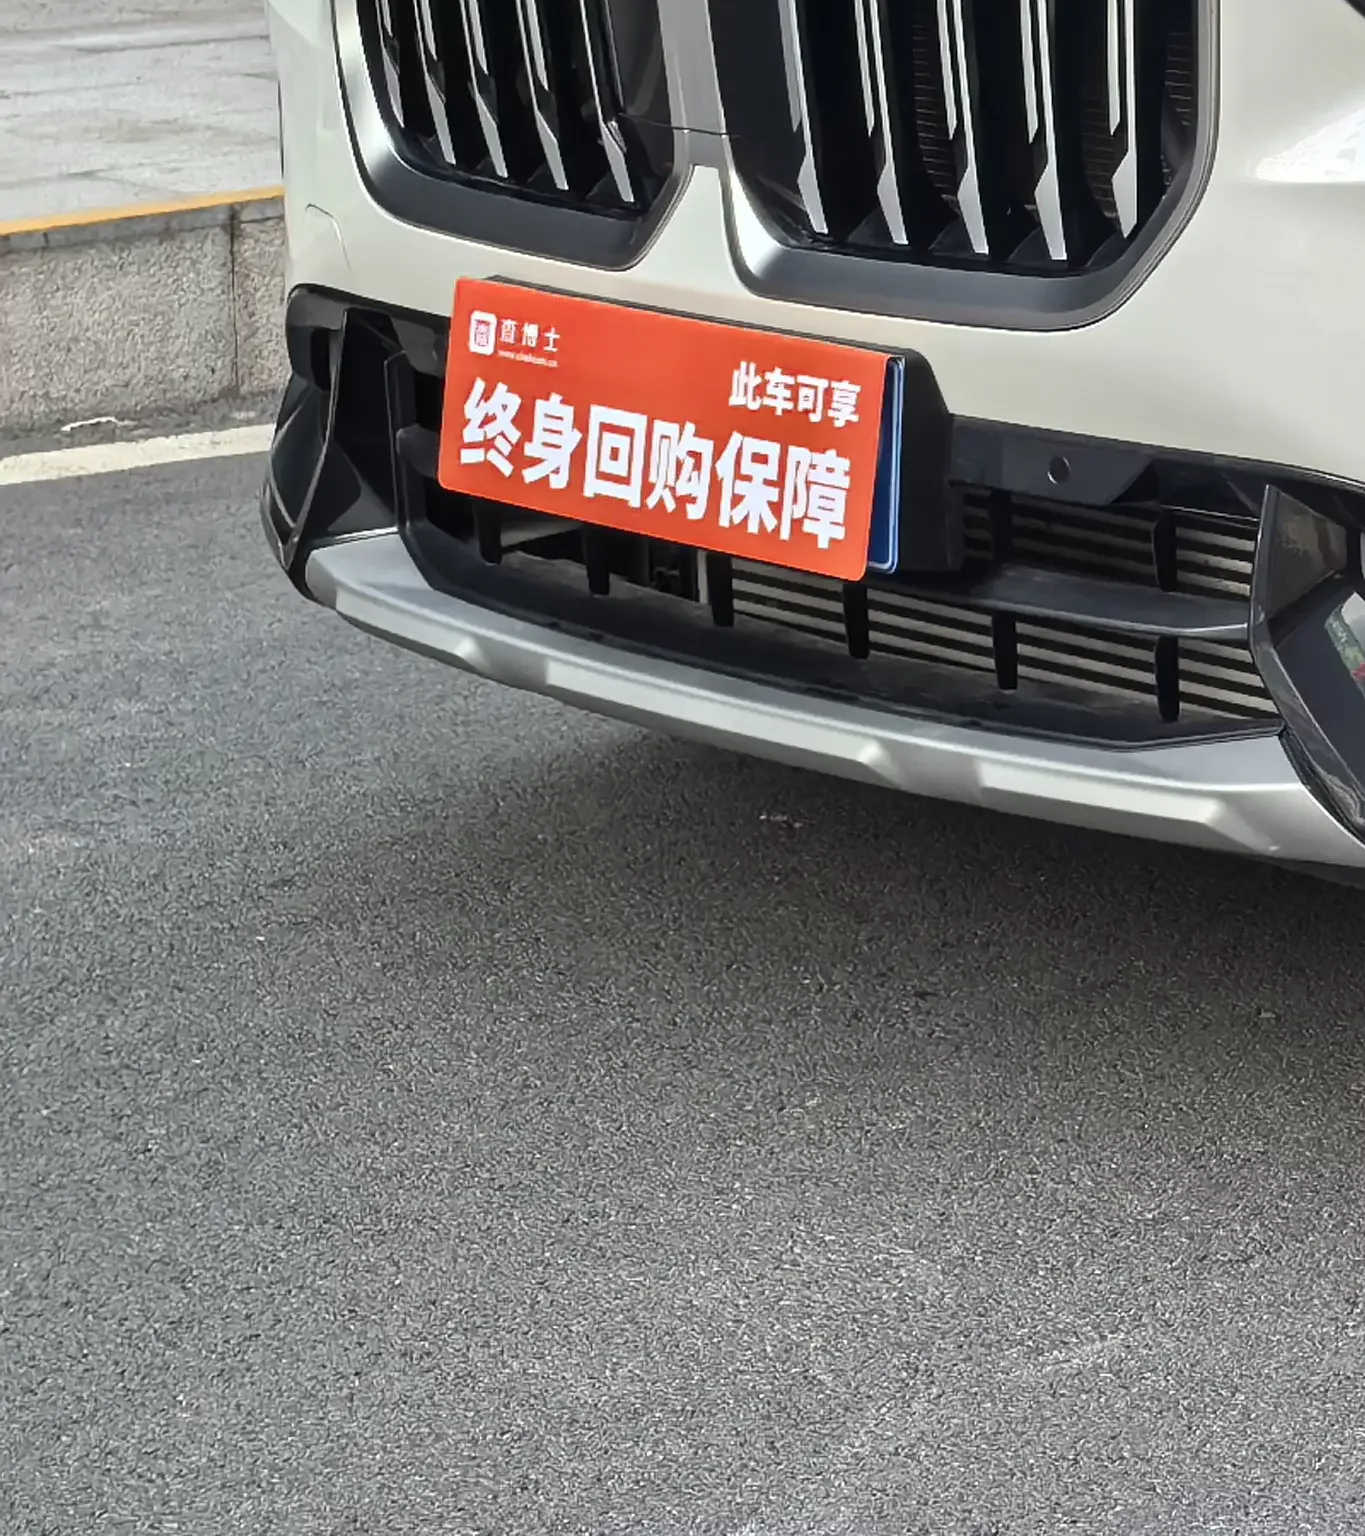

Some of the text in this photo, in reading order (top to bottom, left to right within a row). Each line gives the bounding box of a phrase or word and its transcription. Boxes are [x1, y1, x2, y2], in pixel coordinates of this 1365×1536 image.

[728, 361, 861, 427] 此车可享
[460, 377, 851, 549] 终身回购保障
